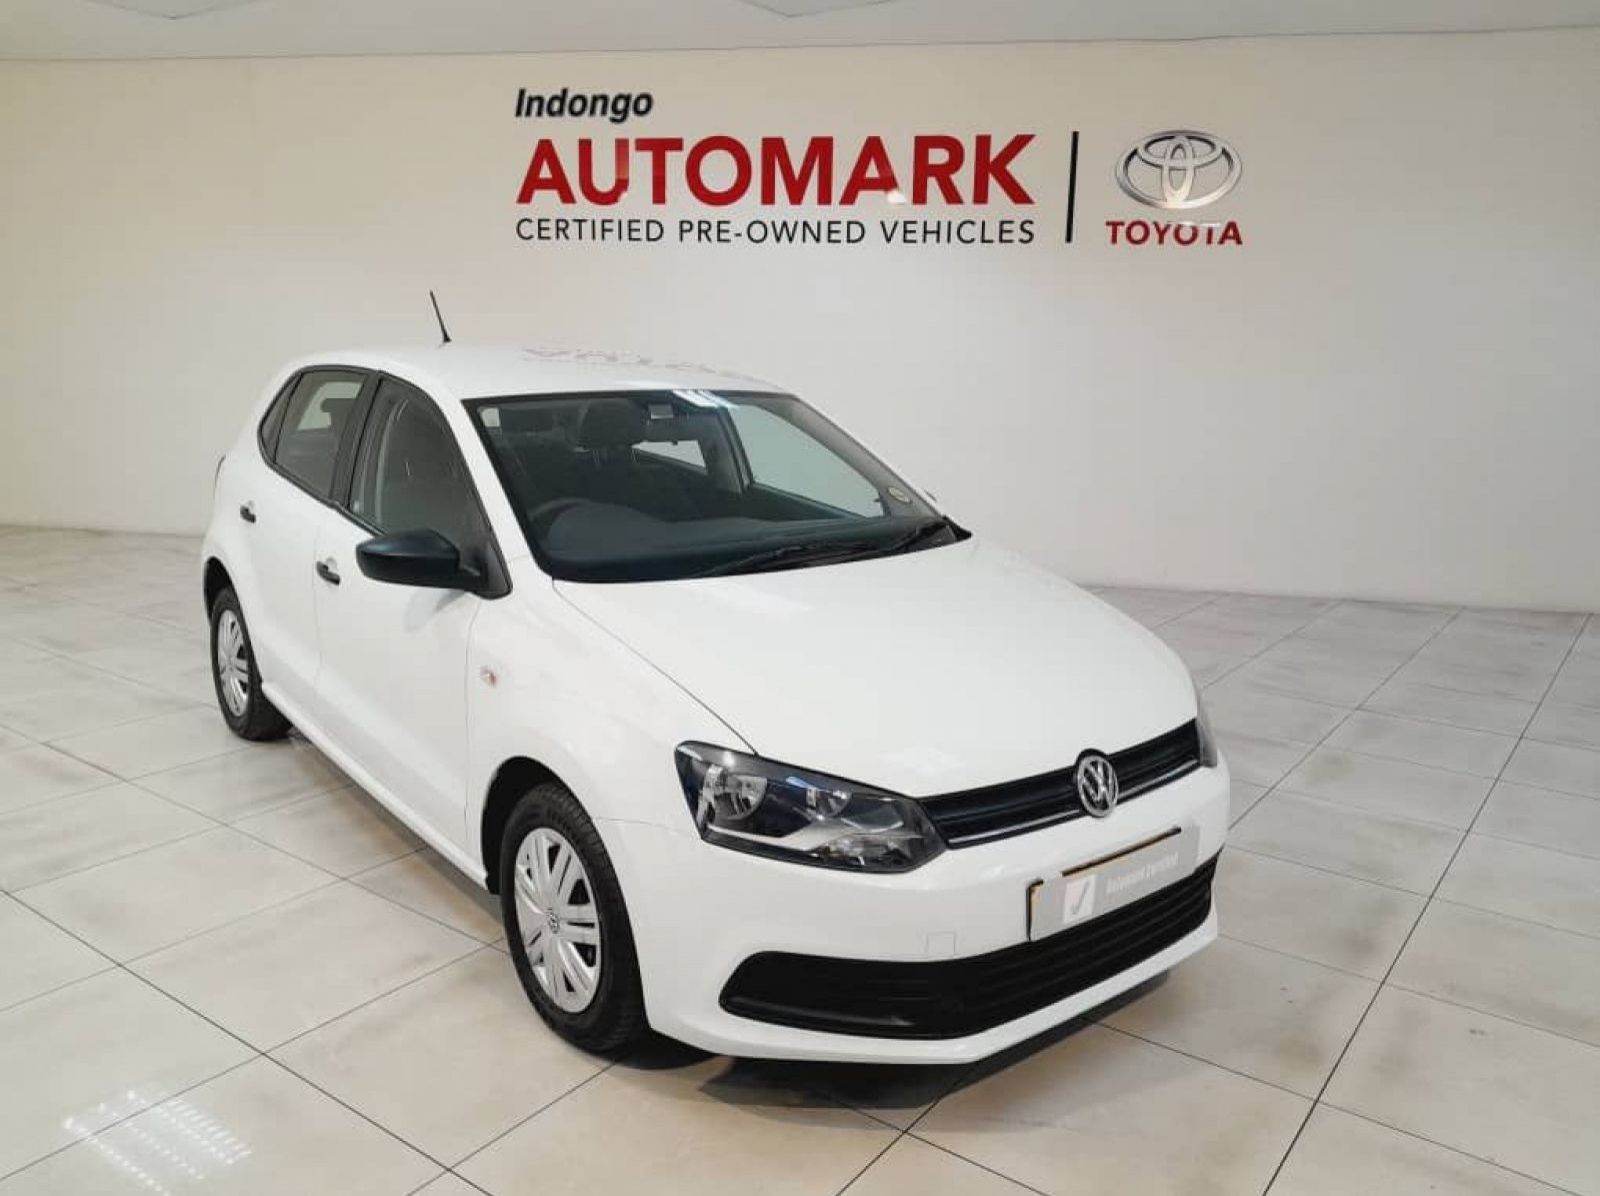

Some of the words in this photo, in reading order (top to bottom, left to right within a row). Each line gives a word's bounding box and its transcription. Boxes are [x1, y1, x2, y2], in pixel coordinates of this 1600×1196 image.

[514, 87, 654, 124] Indongo
[516, 132, 1036, 208] AUTOMARK
[515, 217, 665, 243] CERTIFIED
[678, 219, 866, 244] PRE-OWNED
[880, 219, 1035, 245] VEHICLES
[1106, 220, 1243, 247] TOYOTA
[1078, 755, 1116, 818] VW
